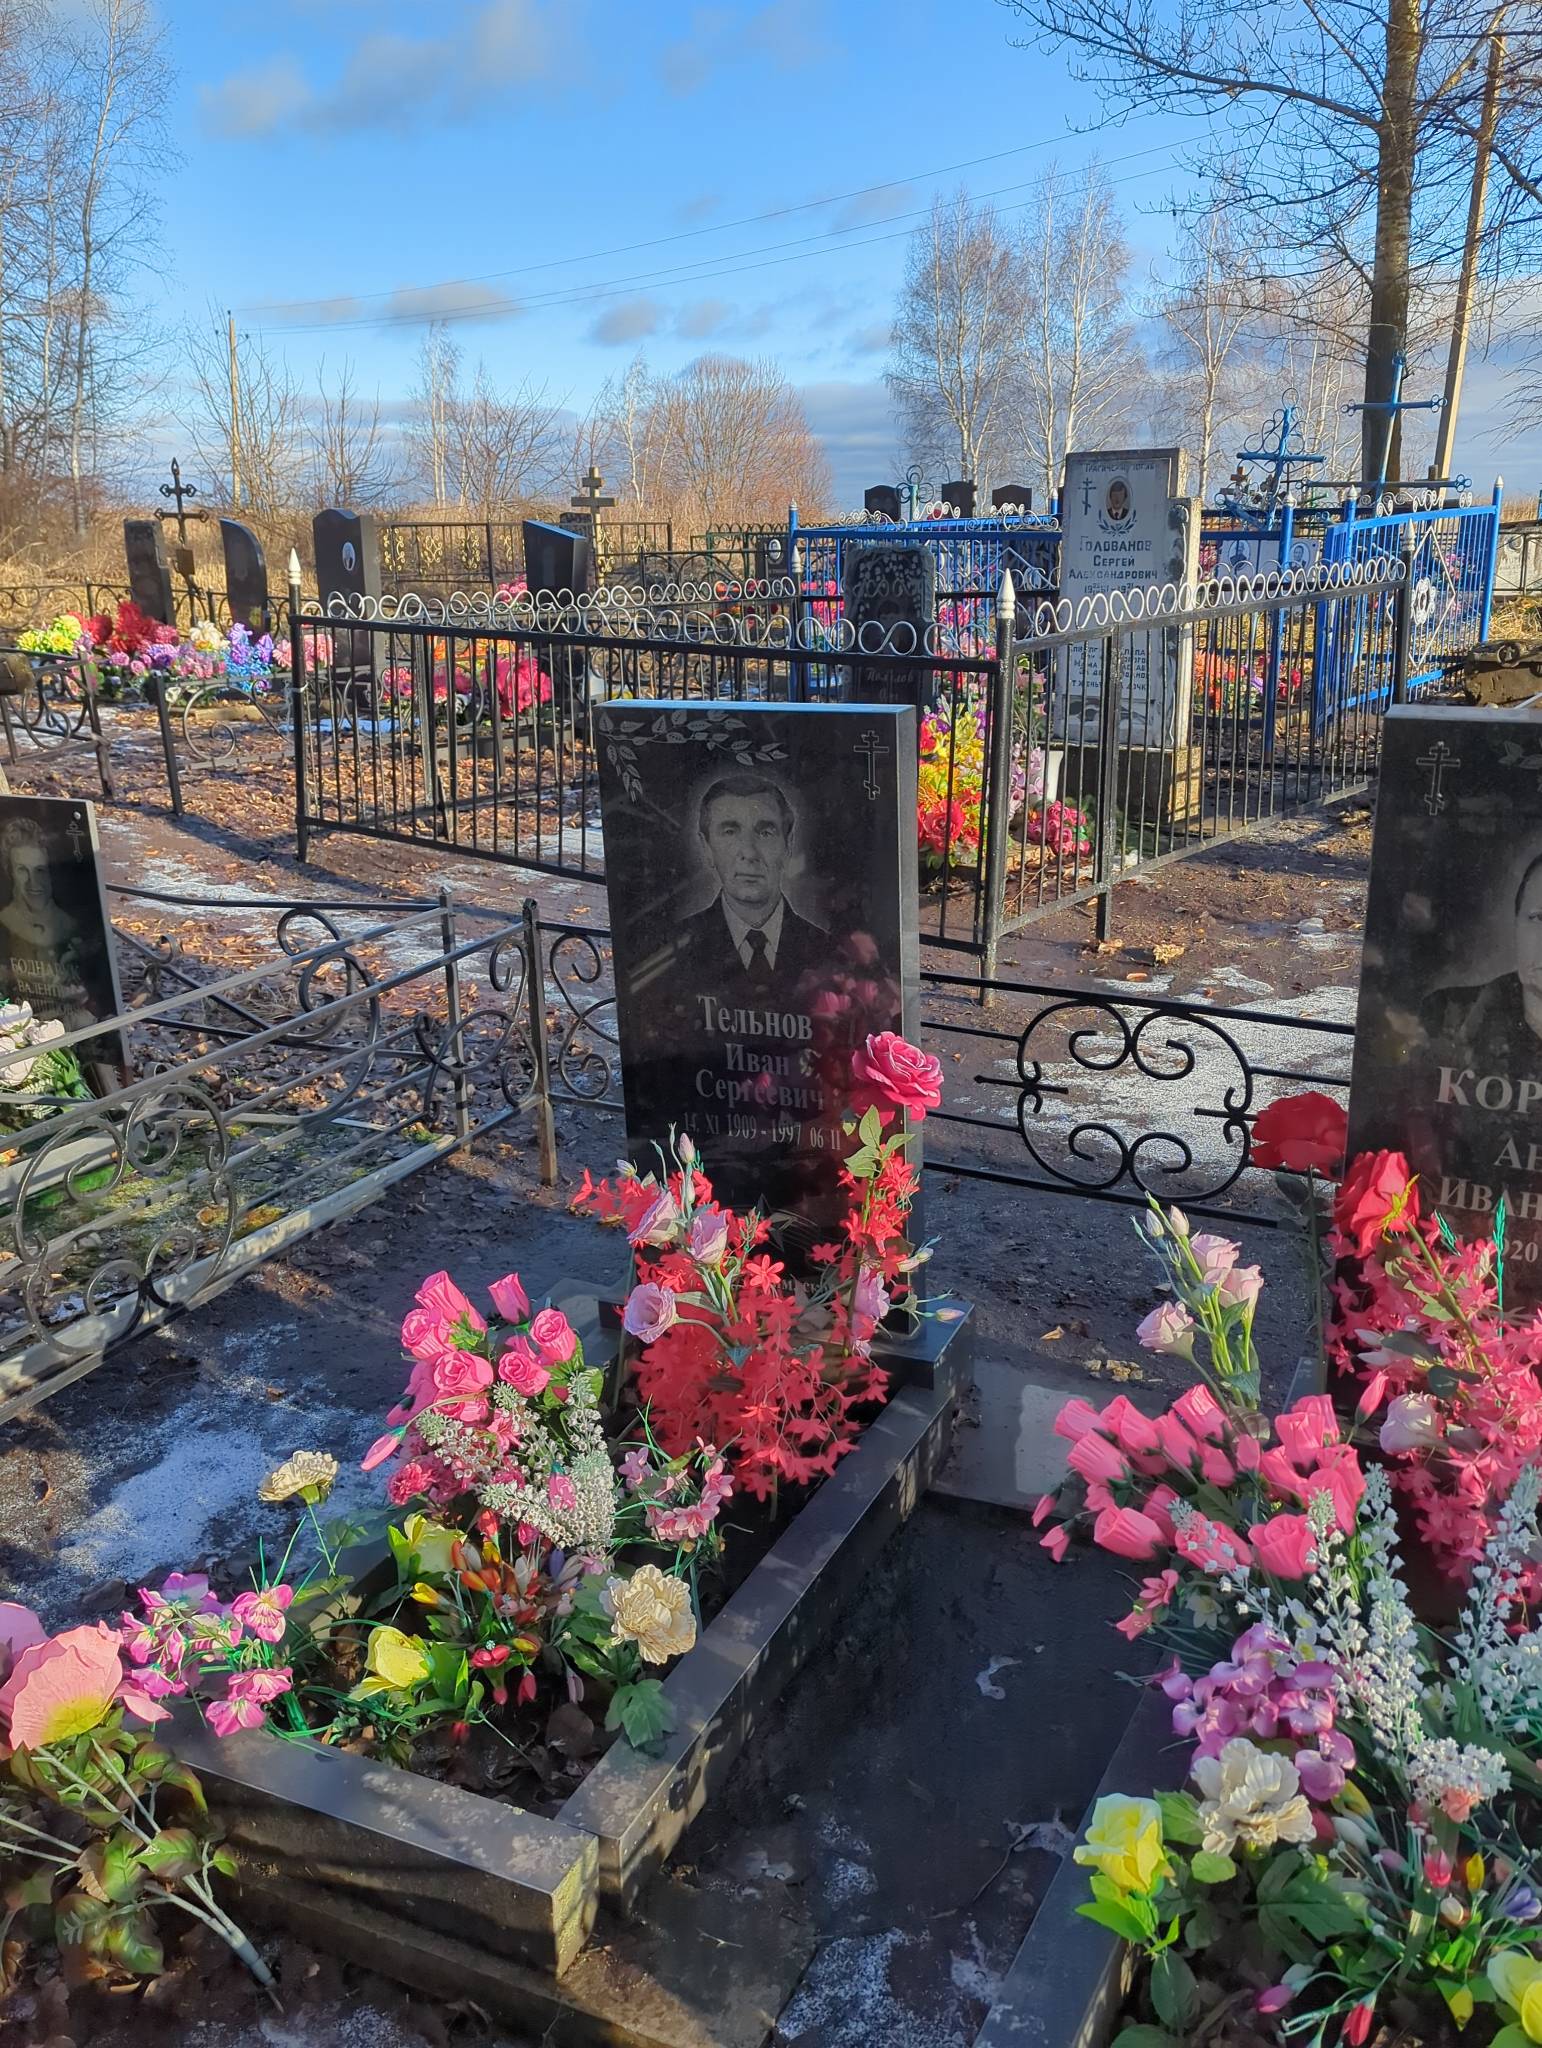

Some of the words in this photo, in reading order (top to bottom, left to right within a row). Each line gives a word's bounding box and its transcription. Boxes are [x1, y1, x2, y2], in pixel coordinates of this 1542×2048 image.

[1093, 554, 1136, 567] СЕРГЕЙ
[697, 994, 812, 1039] Тельнов
[724, 1042, 790, 1076] Иван
[695, 1068, 824, 1111] Сергеевич
[1435, 1066, 1542, 1114] КОР
[726, 1112, 757, 1140] 1909
[771, 1118, 802, 1146] 1997
[810, 1127, 825, 1149] 06
